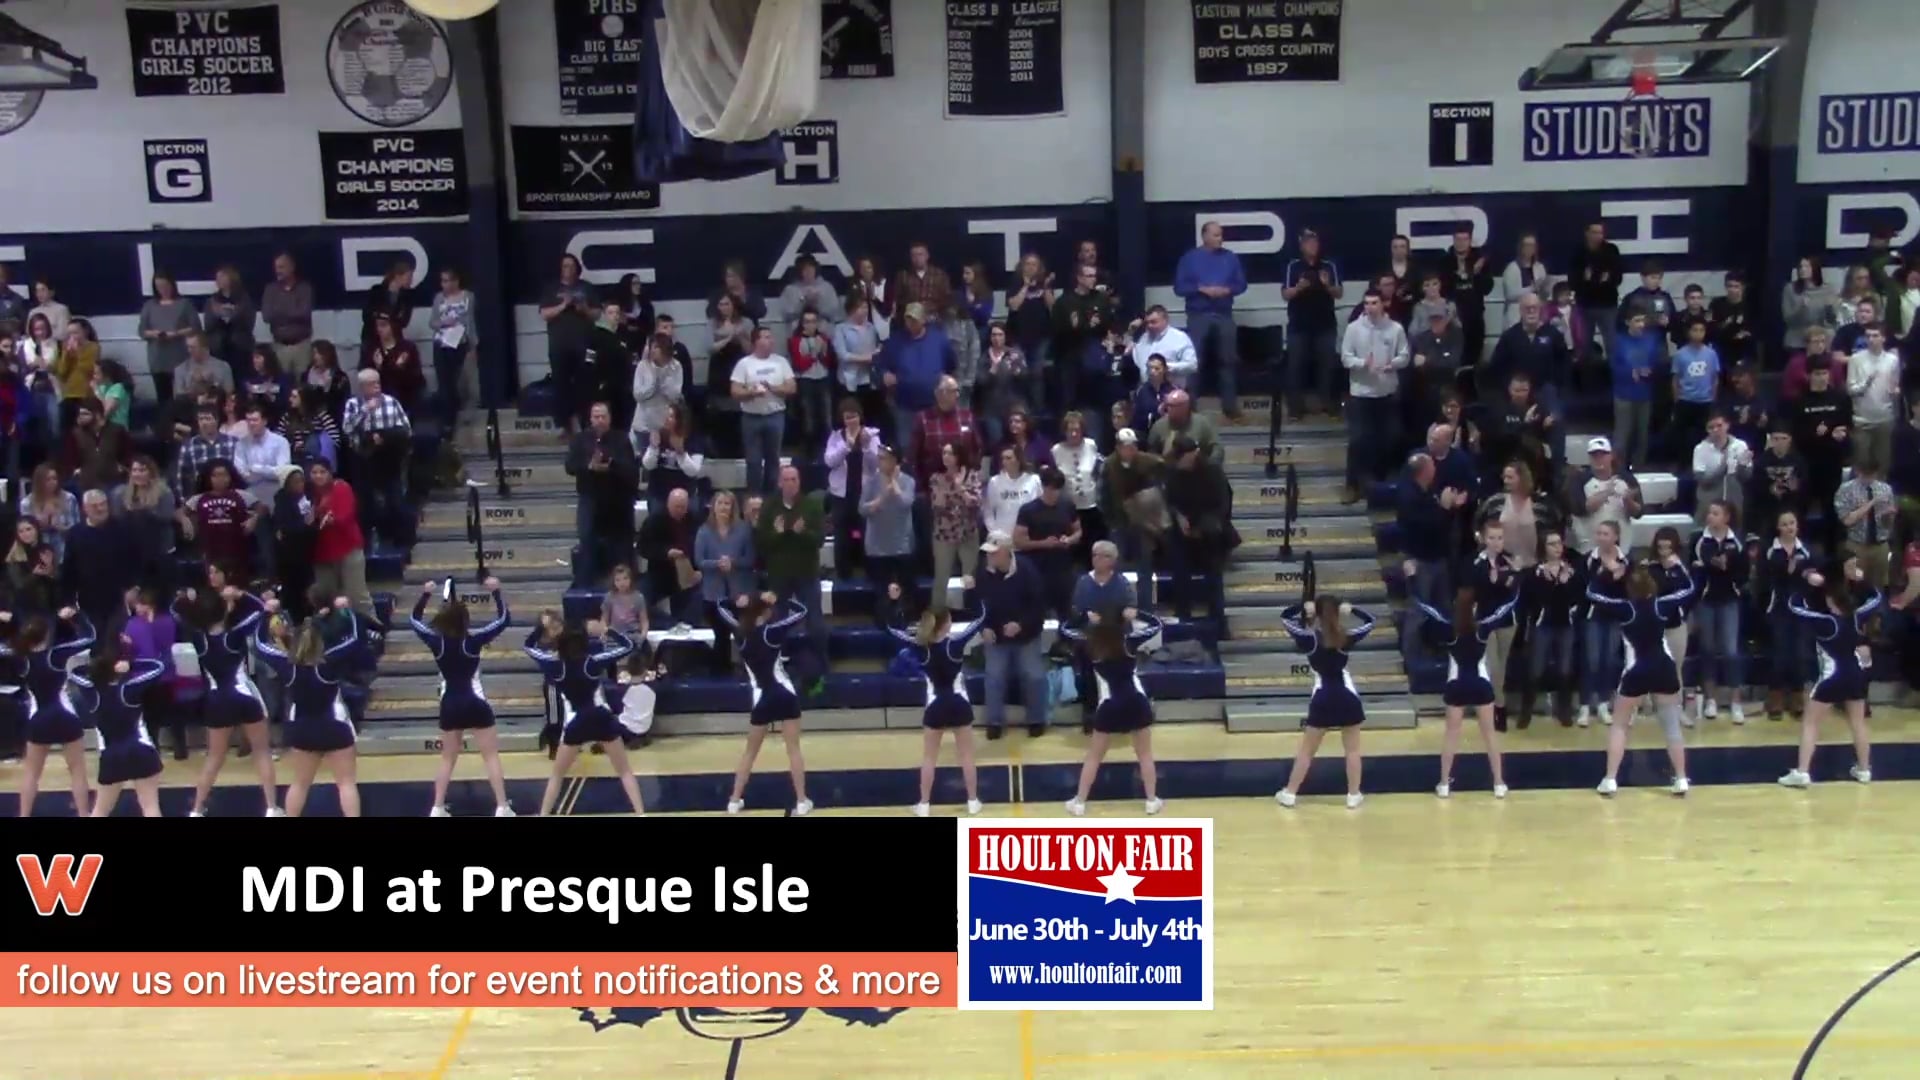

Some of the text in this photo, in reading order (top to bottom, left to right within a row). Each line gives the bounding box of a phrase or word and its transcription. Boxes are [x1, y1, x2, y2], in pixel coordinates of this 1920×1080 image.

[947, 1, 1060, 16] CLASS B LEAGUE
[1195, 2, 1340, 18] EASTERN MAINE CHAMPIONS
[176, 12, 230, 34] PVC
[1219, 22, 1315, 39] CLASS A
[151, 36, 261, 56] CHAMPIONS
[584, 40, 606, 52] BIG
[1199, 42, 1335, 58] BOYS CROSS COUNTRY
[141, 56, 275, 76] GIRLS SOCCER
[1247, 62, 1289, 76] 1997
[187, 77, 232, 95] 2012
[1432, 106, 1491, 119] SECTION
[1531, 103, 1703, 156] STUDENTS
[1825, 97, 1920, 149] STUD
[146, 144, 206, 155] SECTION
[373, 138, 415, 153] PVC
[1455, 122, 1468, 162] I
[338, 158, 455, 175] CHAMPIONS
[782, 140, 831, 179] H
[154, 158, 204, 198] G
[336, 178, 456, 194] GIRLS SOCCER
[526, 190, 651, 203] SPORTSMANSHIP AWARD
[376, 198, 420, 212] 2014
[514, 420, 542, 430] ROW
[485, 509, 525, 518] ROW 6
[461, 594, 490, 604] ROW
